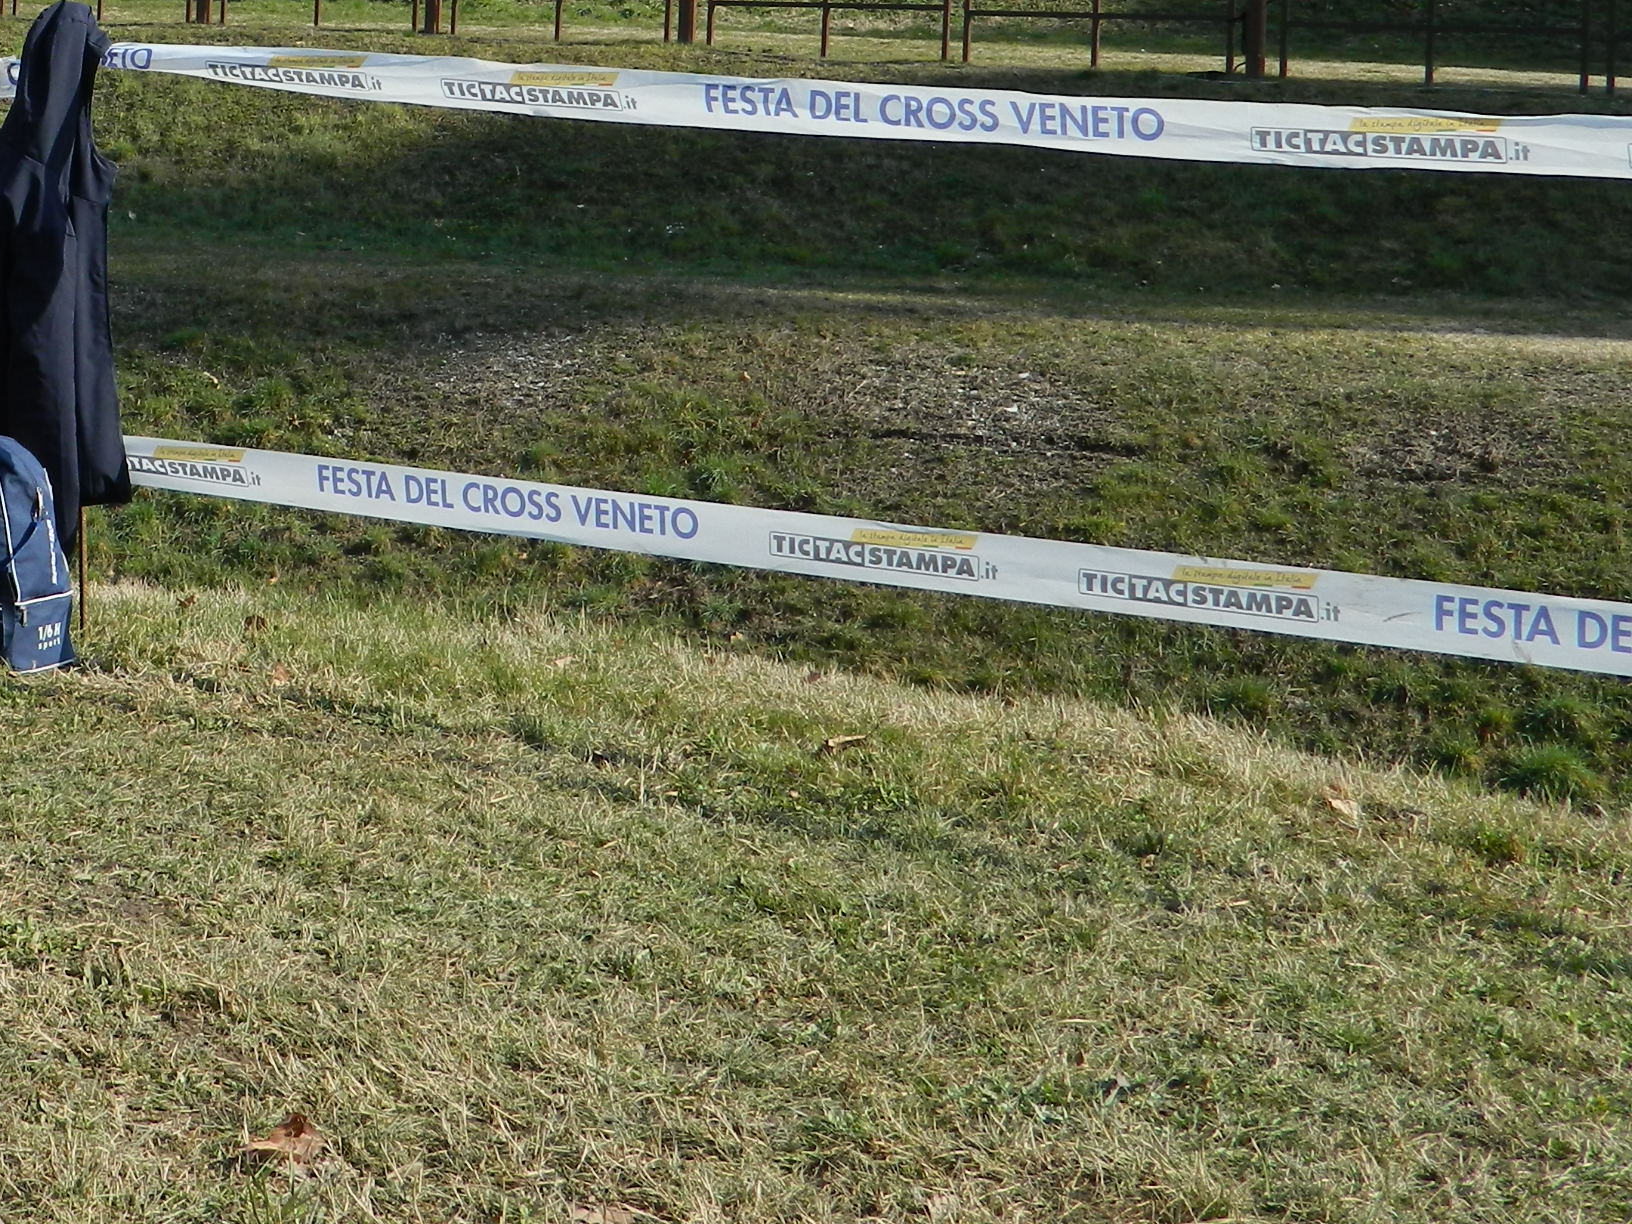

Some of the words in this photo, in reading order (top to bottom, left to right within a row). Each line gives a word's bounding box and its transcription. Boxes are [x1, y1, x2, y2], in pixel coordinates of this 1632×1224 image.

[208, 63, 382, 90] TICTACSTAMPA.it
[443, 81, 637, 110] TICTACSTAMPA.it
[704, 84, 799, 118] FESTA
[809, 90, 868, 123] DEL
[879, 94, 999, 132] CROSS
[1009, 101, 1165, 141] VENETO
[1255, 130, 1530, 161] TICTACSTAMPA.it
[128, 457, 261, 486] TACSTAMPA.it
[317, 464, 396, 501] FESTA
[404, 475, 454, 509] DEL
[462, 482, 562, 522] CROSS
[571, 494, 699, 540] VENETO
[773, 535, 998, 580] TICTACSTAMPA.it
[1082, 572, 1341, 622] TICTACSTAMPA.it
[1434, 594, 1560, 645] FESTA
[1577, 610, 1632, 653] DE
[38, 637, 61, 651] sport
